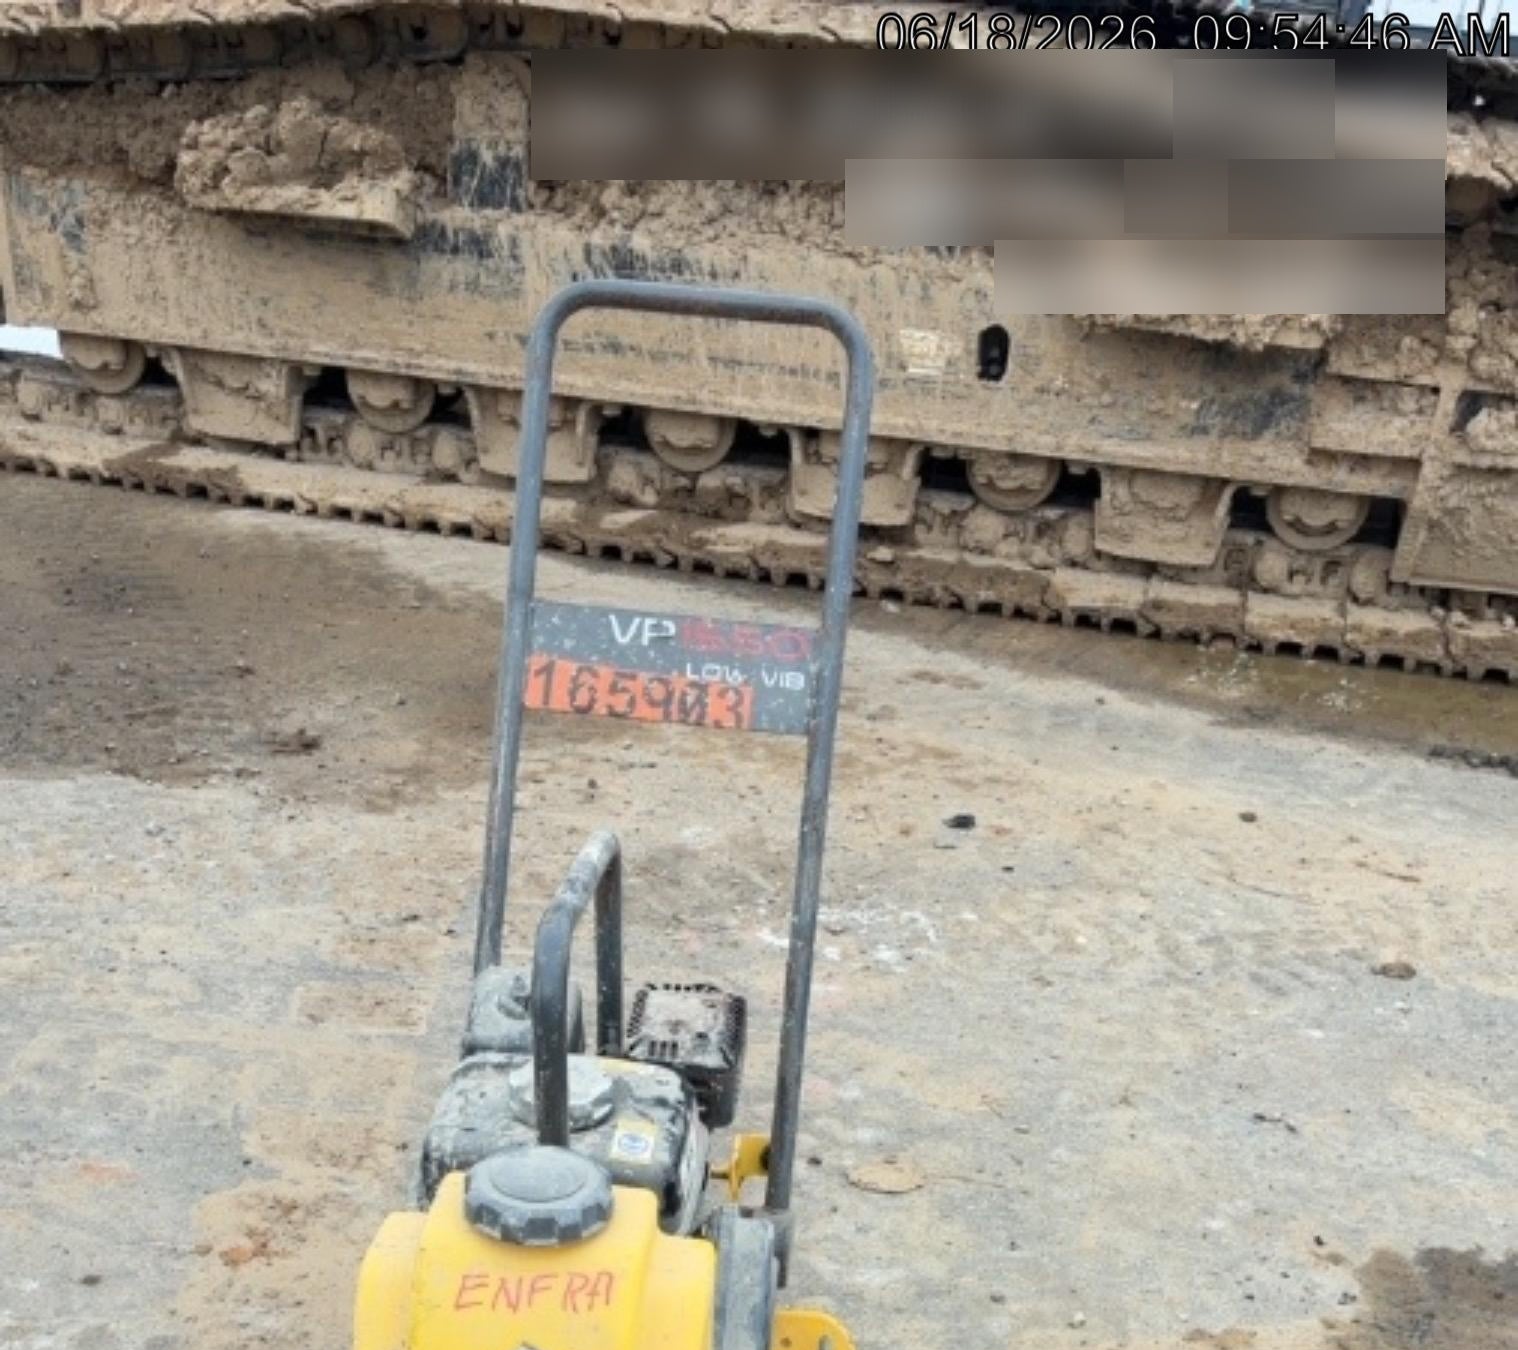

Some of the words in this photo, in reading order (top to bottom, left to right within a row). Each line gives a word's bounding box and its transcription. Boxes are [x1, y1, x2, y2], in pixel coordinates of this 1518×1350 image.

[530, 660, 746, 728] 165903
[686, 662, 745, 686] LOW
[761, 664, 806, 690] VIB
[454, 1270, 615, 1315] ENFRA
